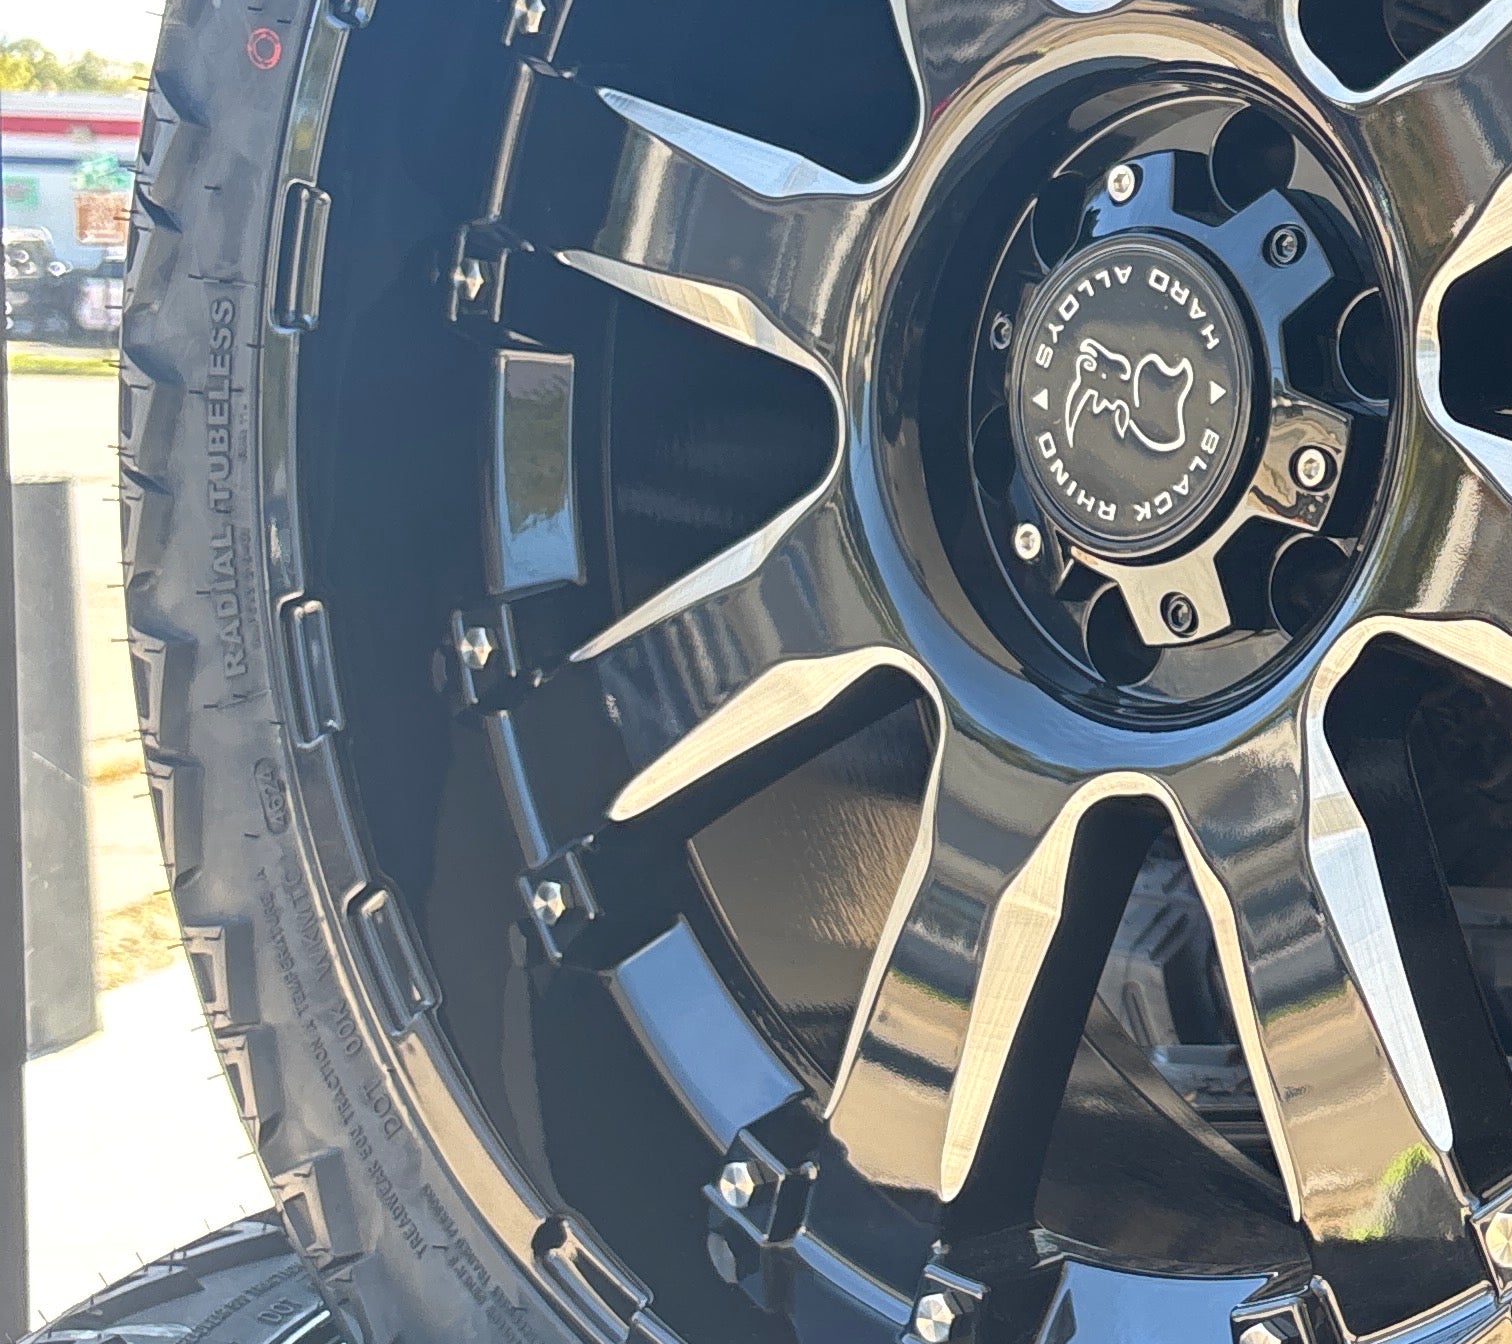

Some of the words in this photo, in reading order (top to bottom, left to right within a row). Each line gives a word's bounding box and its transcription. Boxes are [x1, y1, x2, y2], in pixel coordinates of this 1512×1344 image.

[1034, 265, 1133, 370] ALLOYS
[1148, 267, 1221, 351] HARD
[1037, 430, 1118, 522] RHINO
[1133, 428, 1220, 522] BLACK
[208, 523, 250, 680] RADIAL
[260, 761, 291, 830] 4624
[257, 887, 310, 1018] TEMPERATURE
[308, 1034, 356, 1126] TRACTION
[360, 1071, 404, 1142] DOT
[365, 1157, 430, 1261] TREADWEAR
